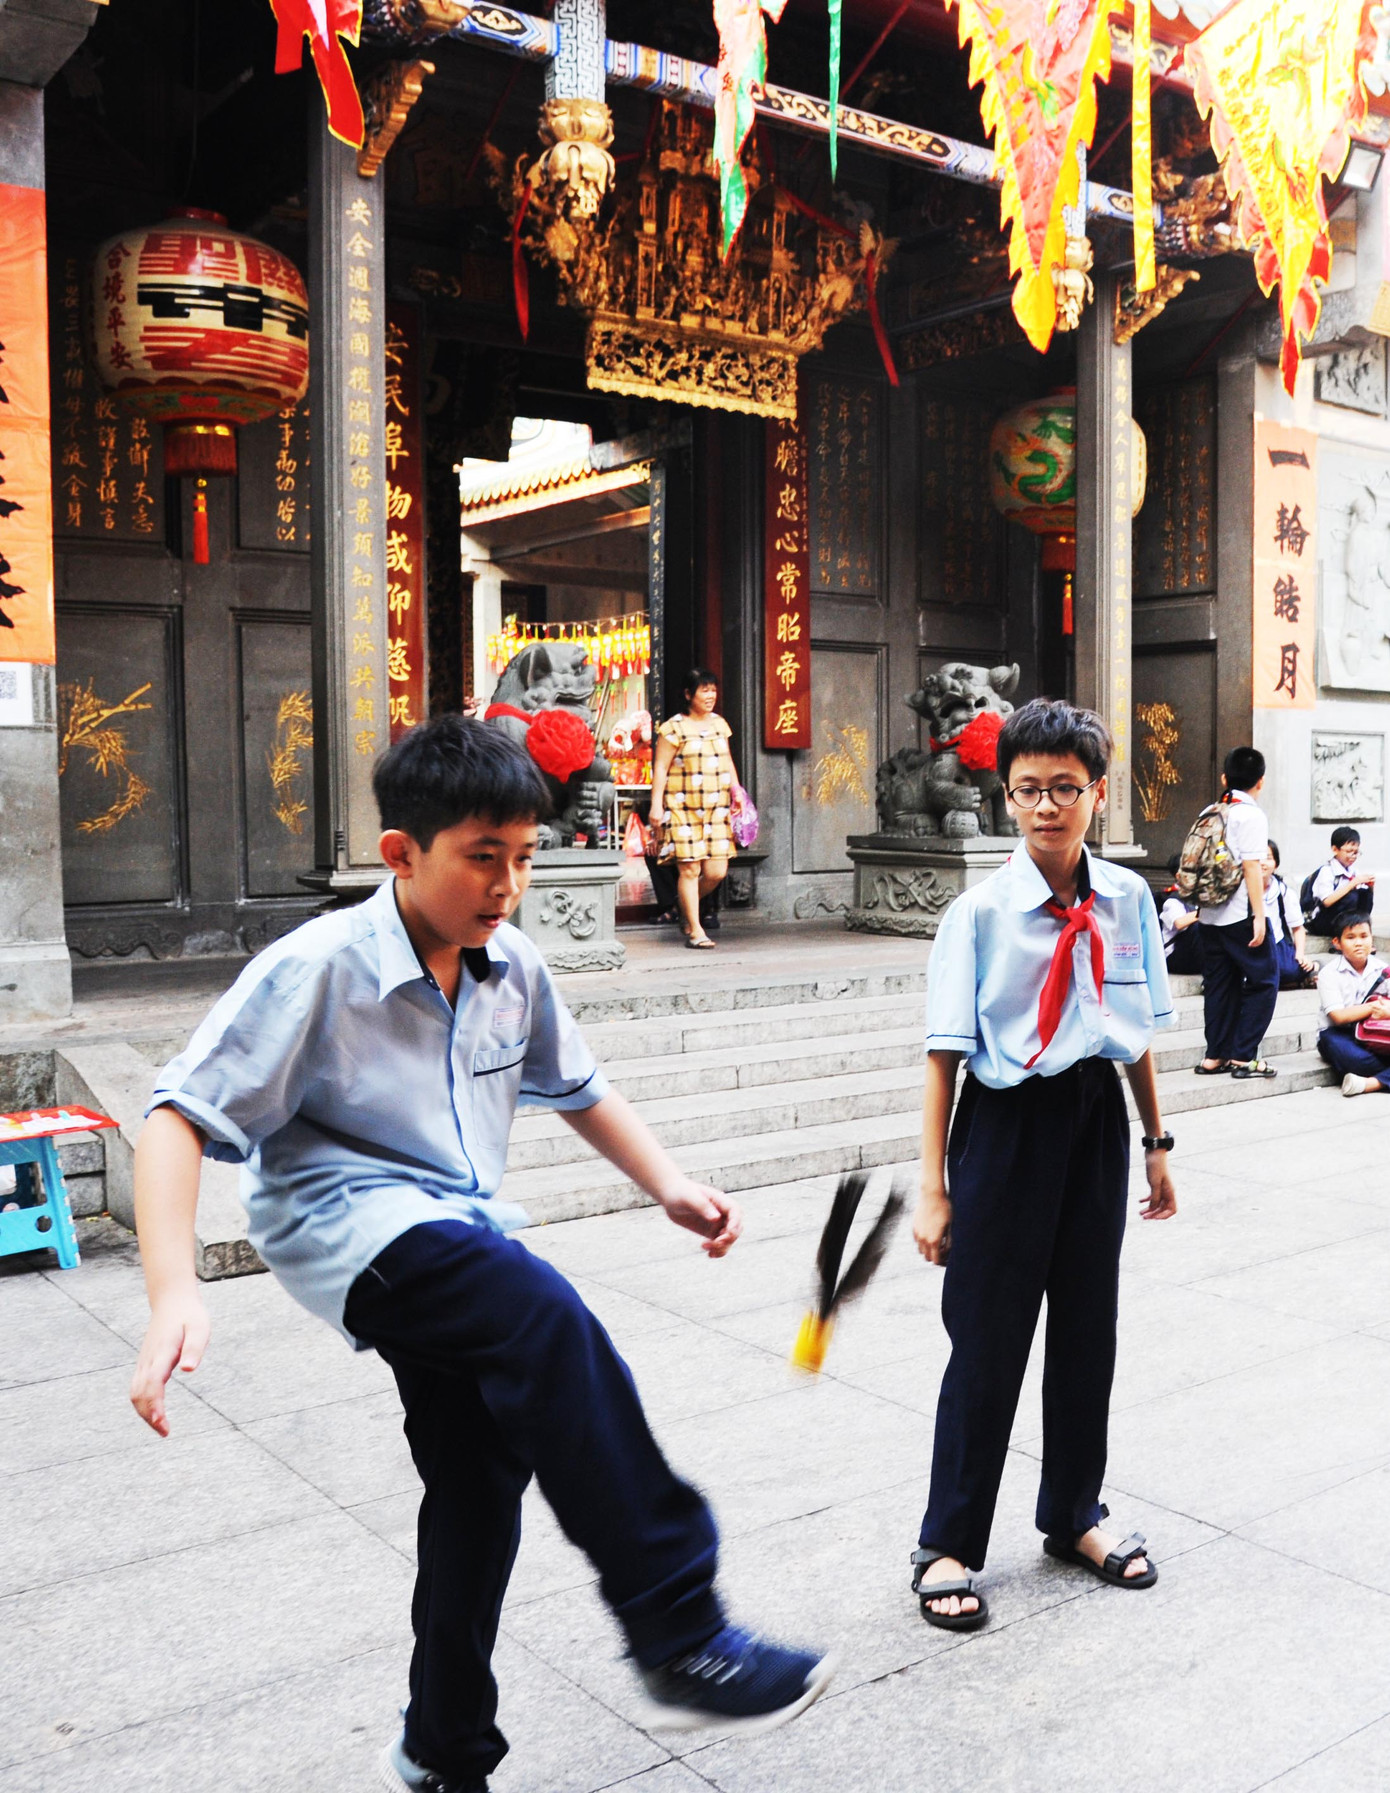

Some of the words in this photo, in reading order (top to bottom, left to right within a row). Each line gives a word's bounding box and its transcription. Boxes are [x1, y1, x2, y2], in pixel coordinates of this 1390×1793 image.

[104, 241, 135, 370] 合境平安
[774, 419, 801, 735] 膽忠心常昭帝座
